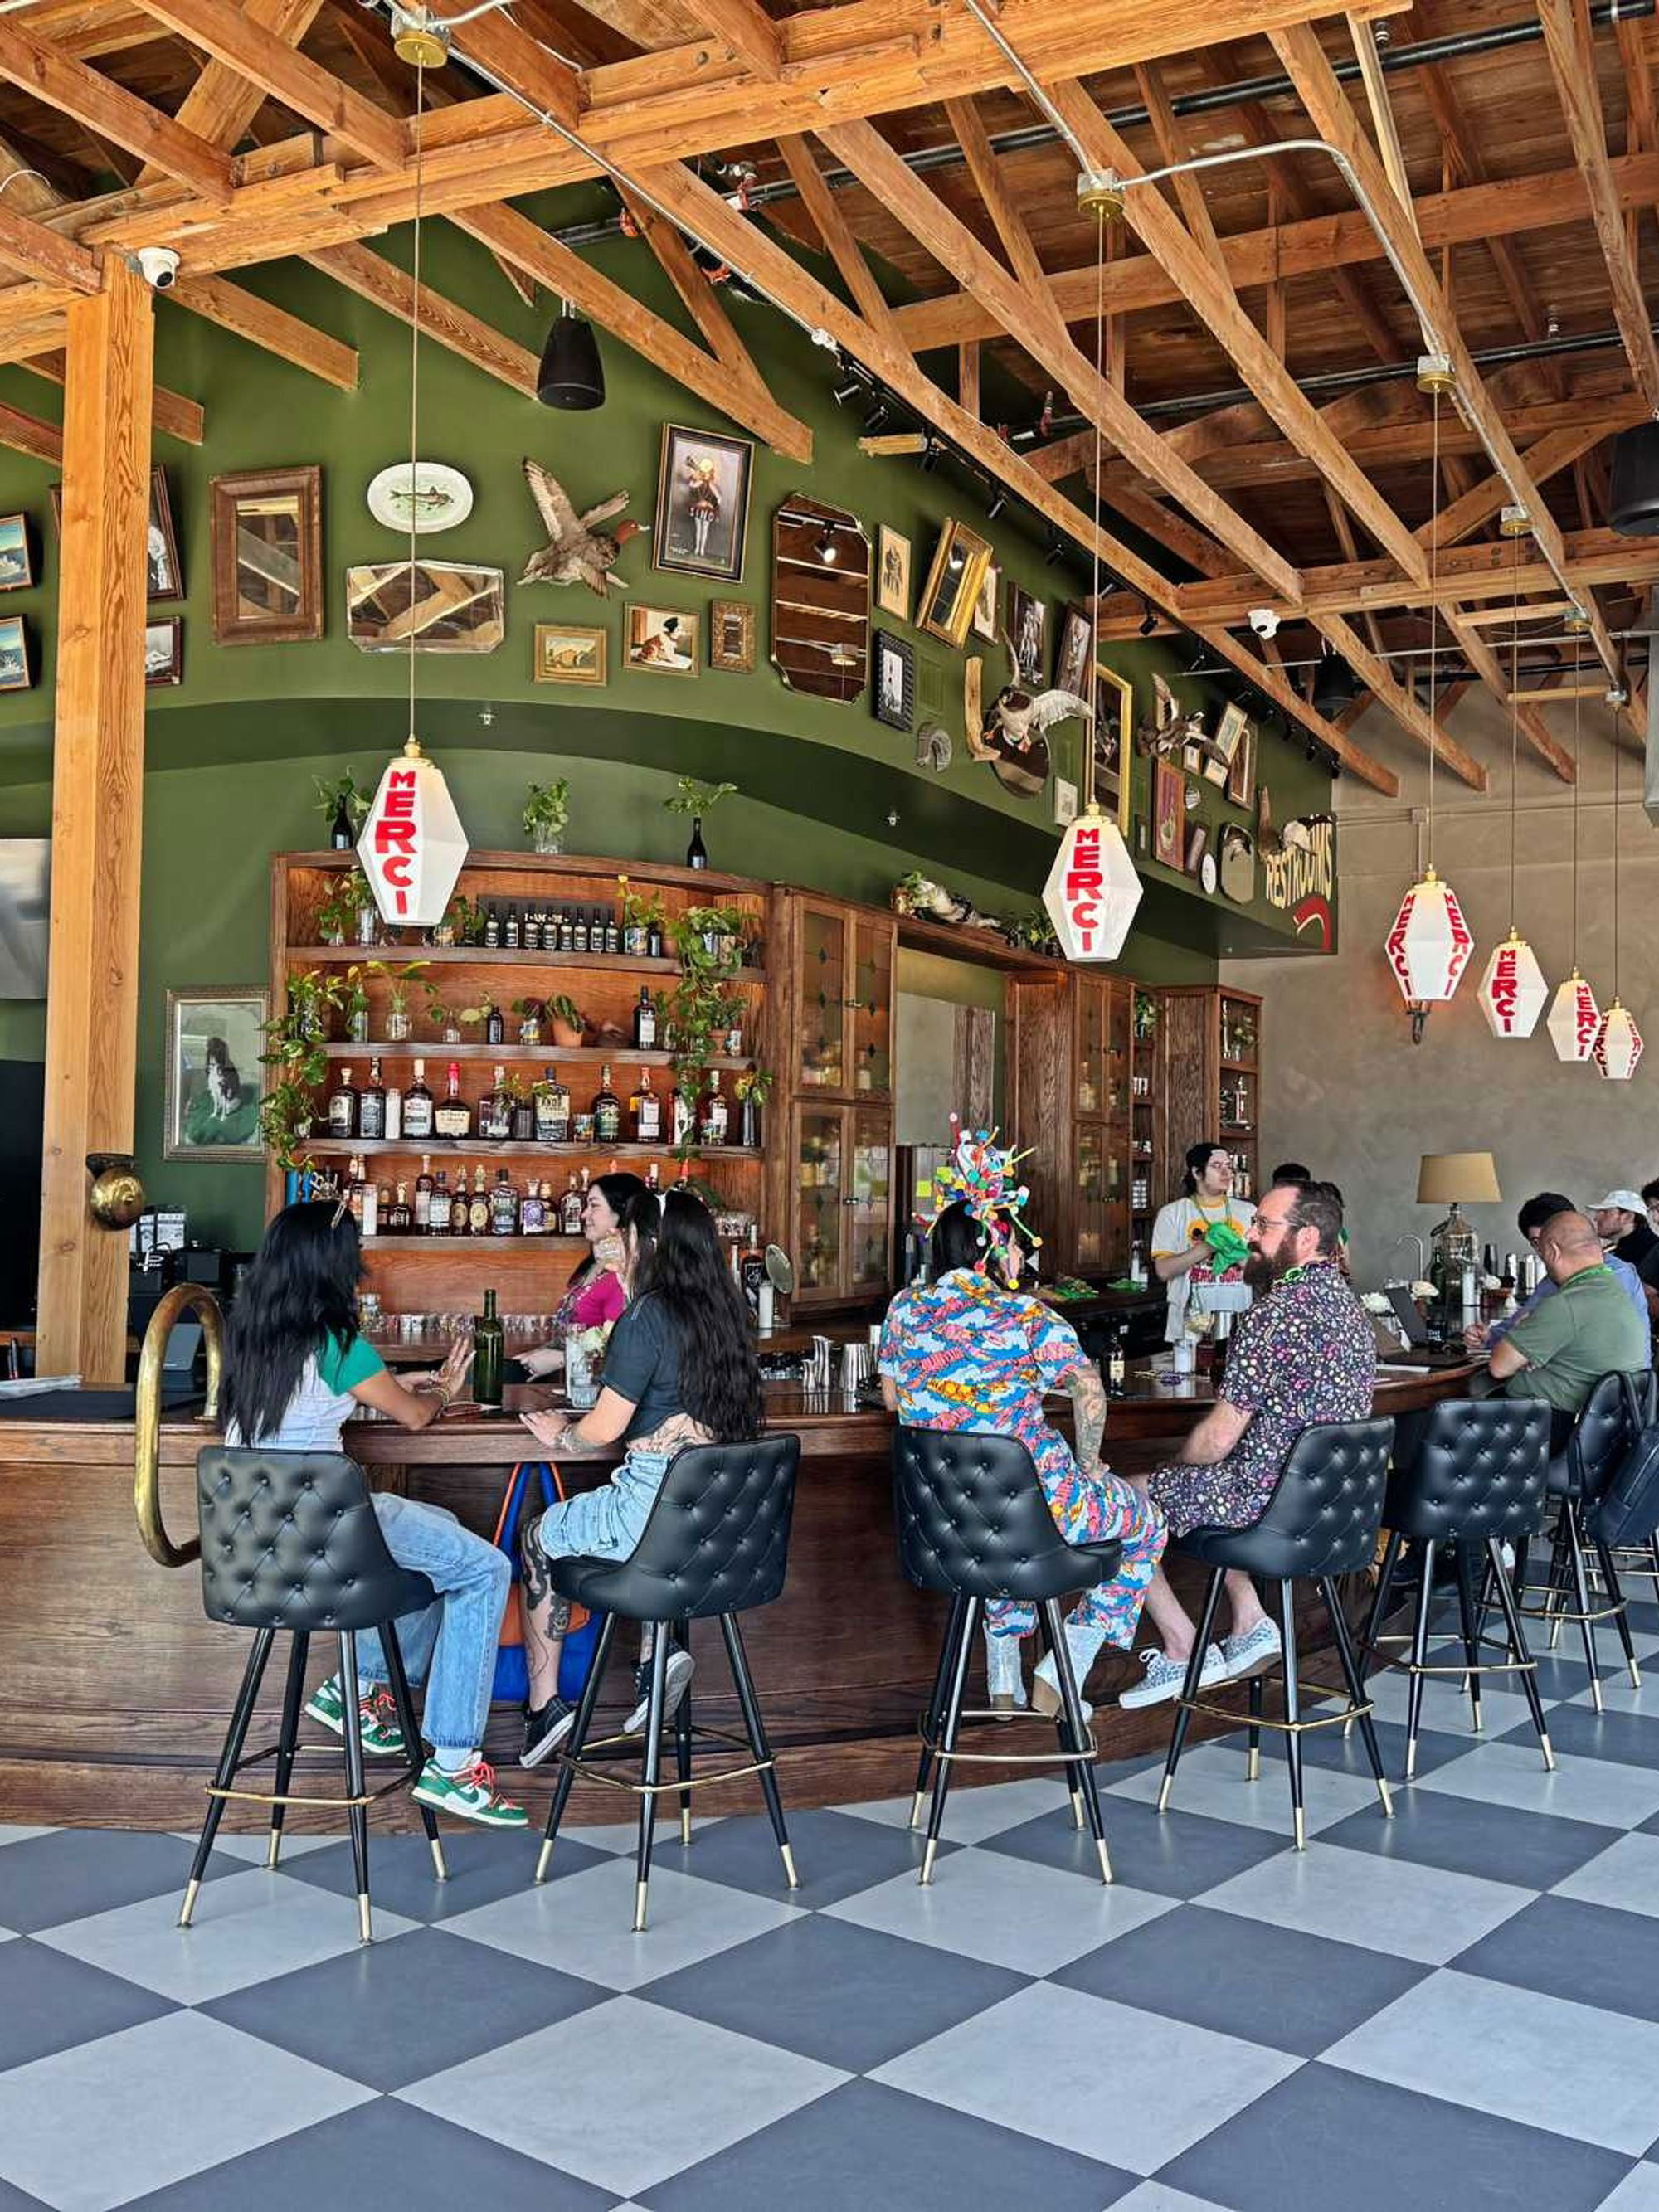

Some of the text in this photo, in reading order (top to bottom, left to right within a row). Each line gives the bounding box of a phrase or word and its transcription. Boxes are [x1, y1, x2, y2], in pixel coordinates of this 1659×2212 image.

[375, 771, 417, 914] MERCI
[1066, 828, 1103, 952] MERCI
[1388, 893, 1416, 996] MERCI
[1443, 892, 1470, 996] MERCI
[1491, 950, 1518, 1033] MERCI
[1576, 985, 1598, 1057] MERCI
[1592, 1014, 1610, 1077] MERCI
